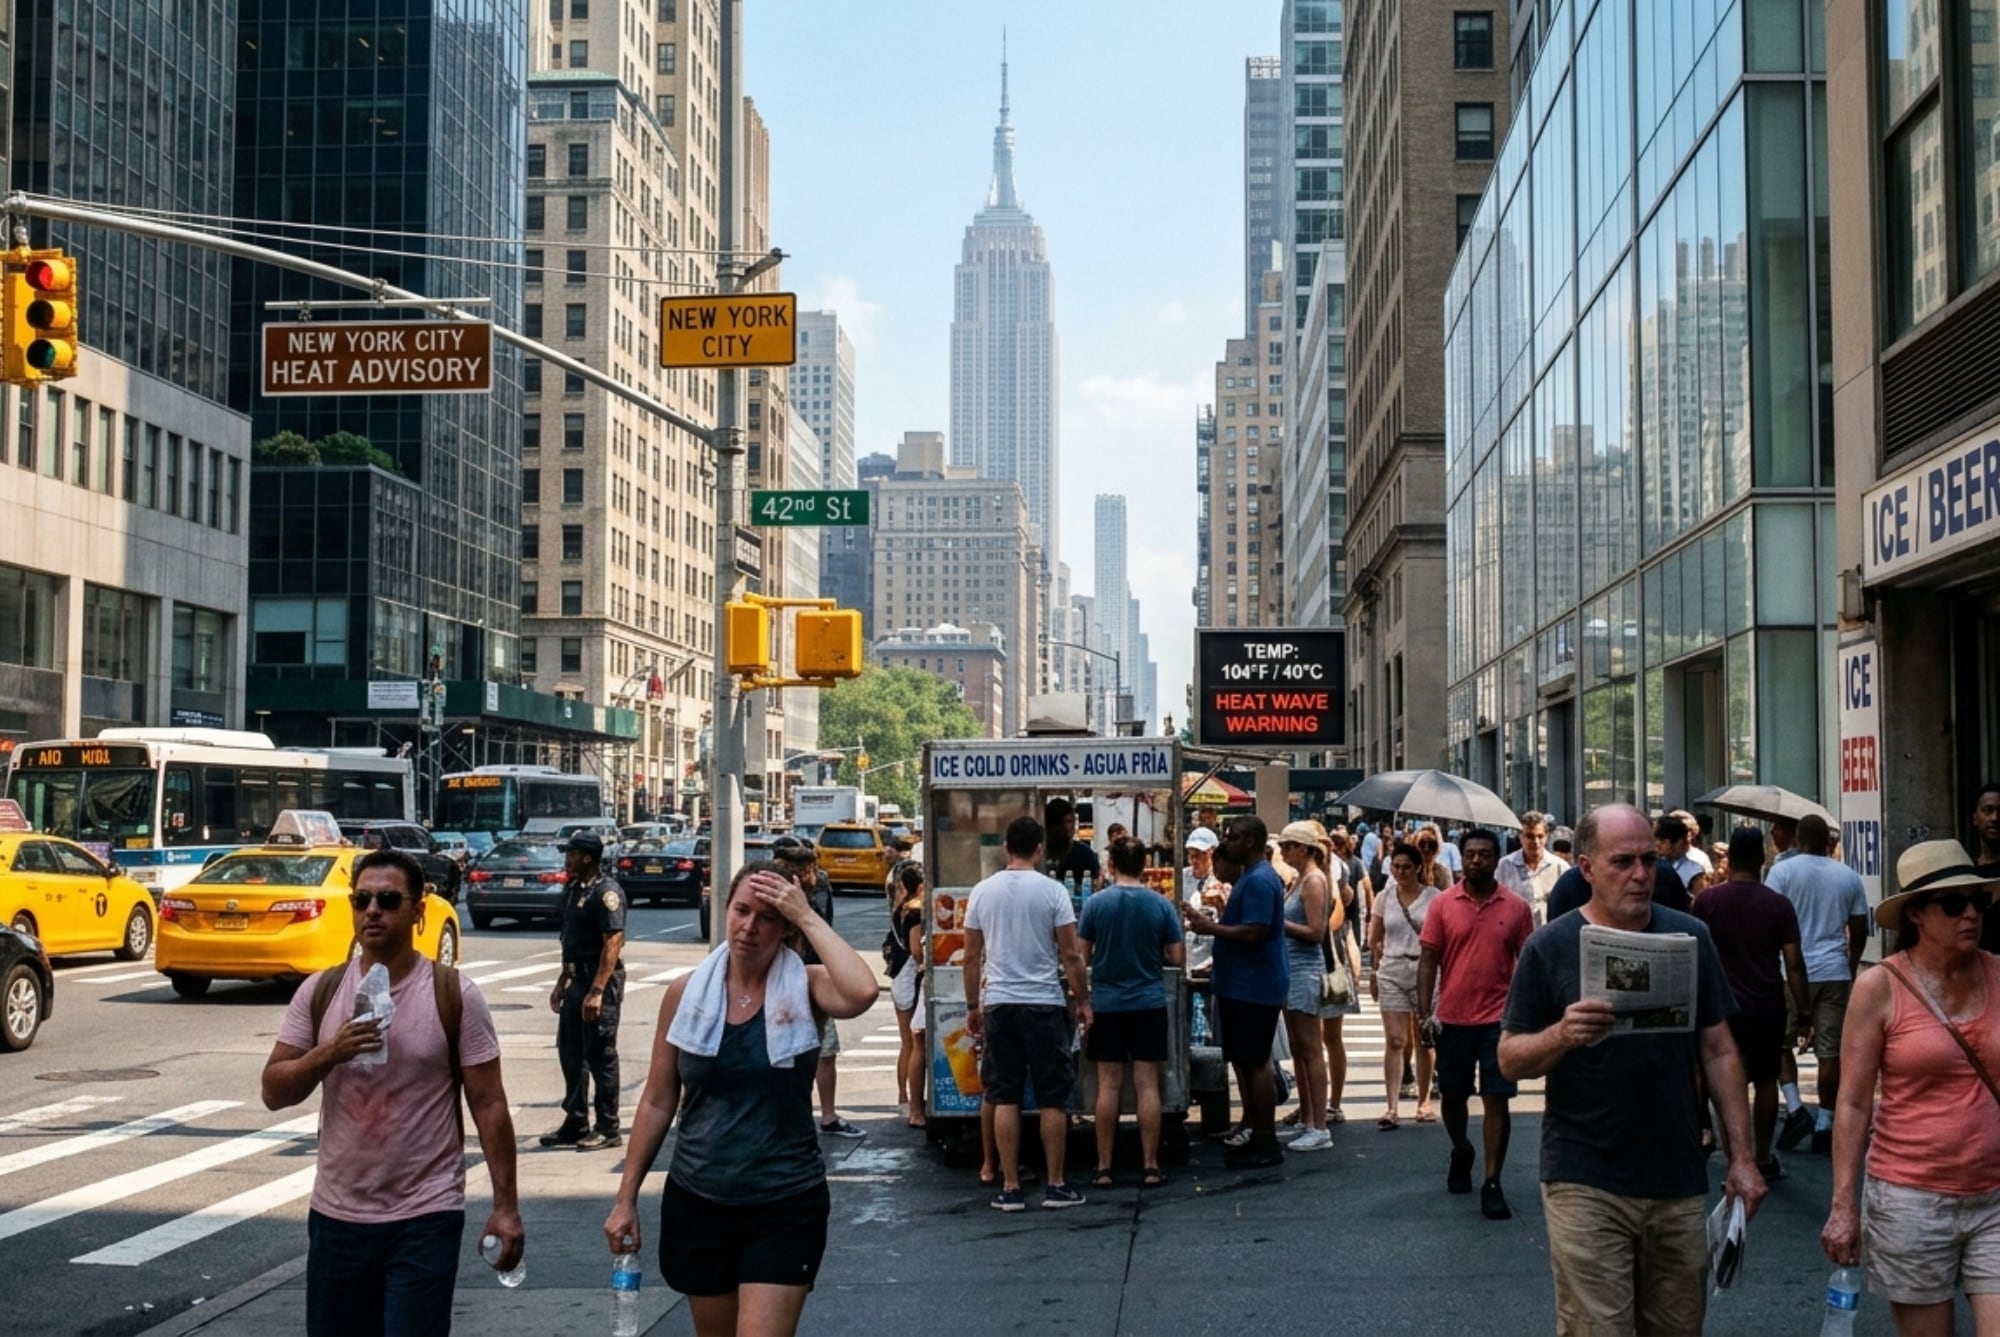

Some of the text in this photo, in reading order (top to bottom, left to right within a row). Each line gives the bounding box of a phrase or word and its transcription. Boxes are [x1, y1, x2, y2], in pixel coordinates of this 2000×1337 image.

[669, 304, 788, 331] NEW YORK
[288, 329, 464, 353] NEW YORK CITY
[702, 334, 753, 358] CITY
[272, 357, 482, 384] HEAT ADVISORY
[761, 496, 852, 520] 42nd St
[1872, 485, 1910, 567] ICE
[1243, 643, 1299, 659] TEMP:
[1221, 664, 1269, 680] 104°F
[1282, 664, 1323, 680] 40°C
[1845, 652, 1872, 711] ICE
[1216, 693, 1329, 710] HEAT WAVE
[1225, 715, 1319, 732] WARNING
[934, 755, 959, 777] ICE
[1083, 752, 1128, 775] AGUA
[1842, 735, 1879, 793] BEER
